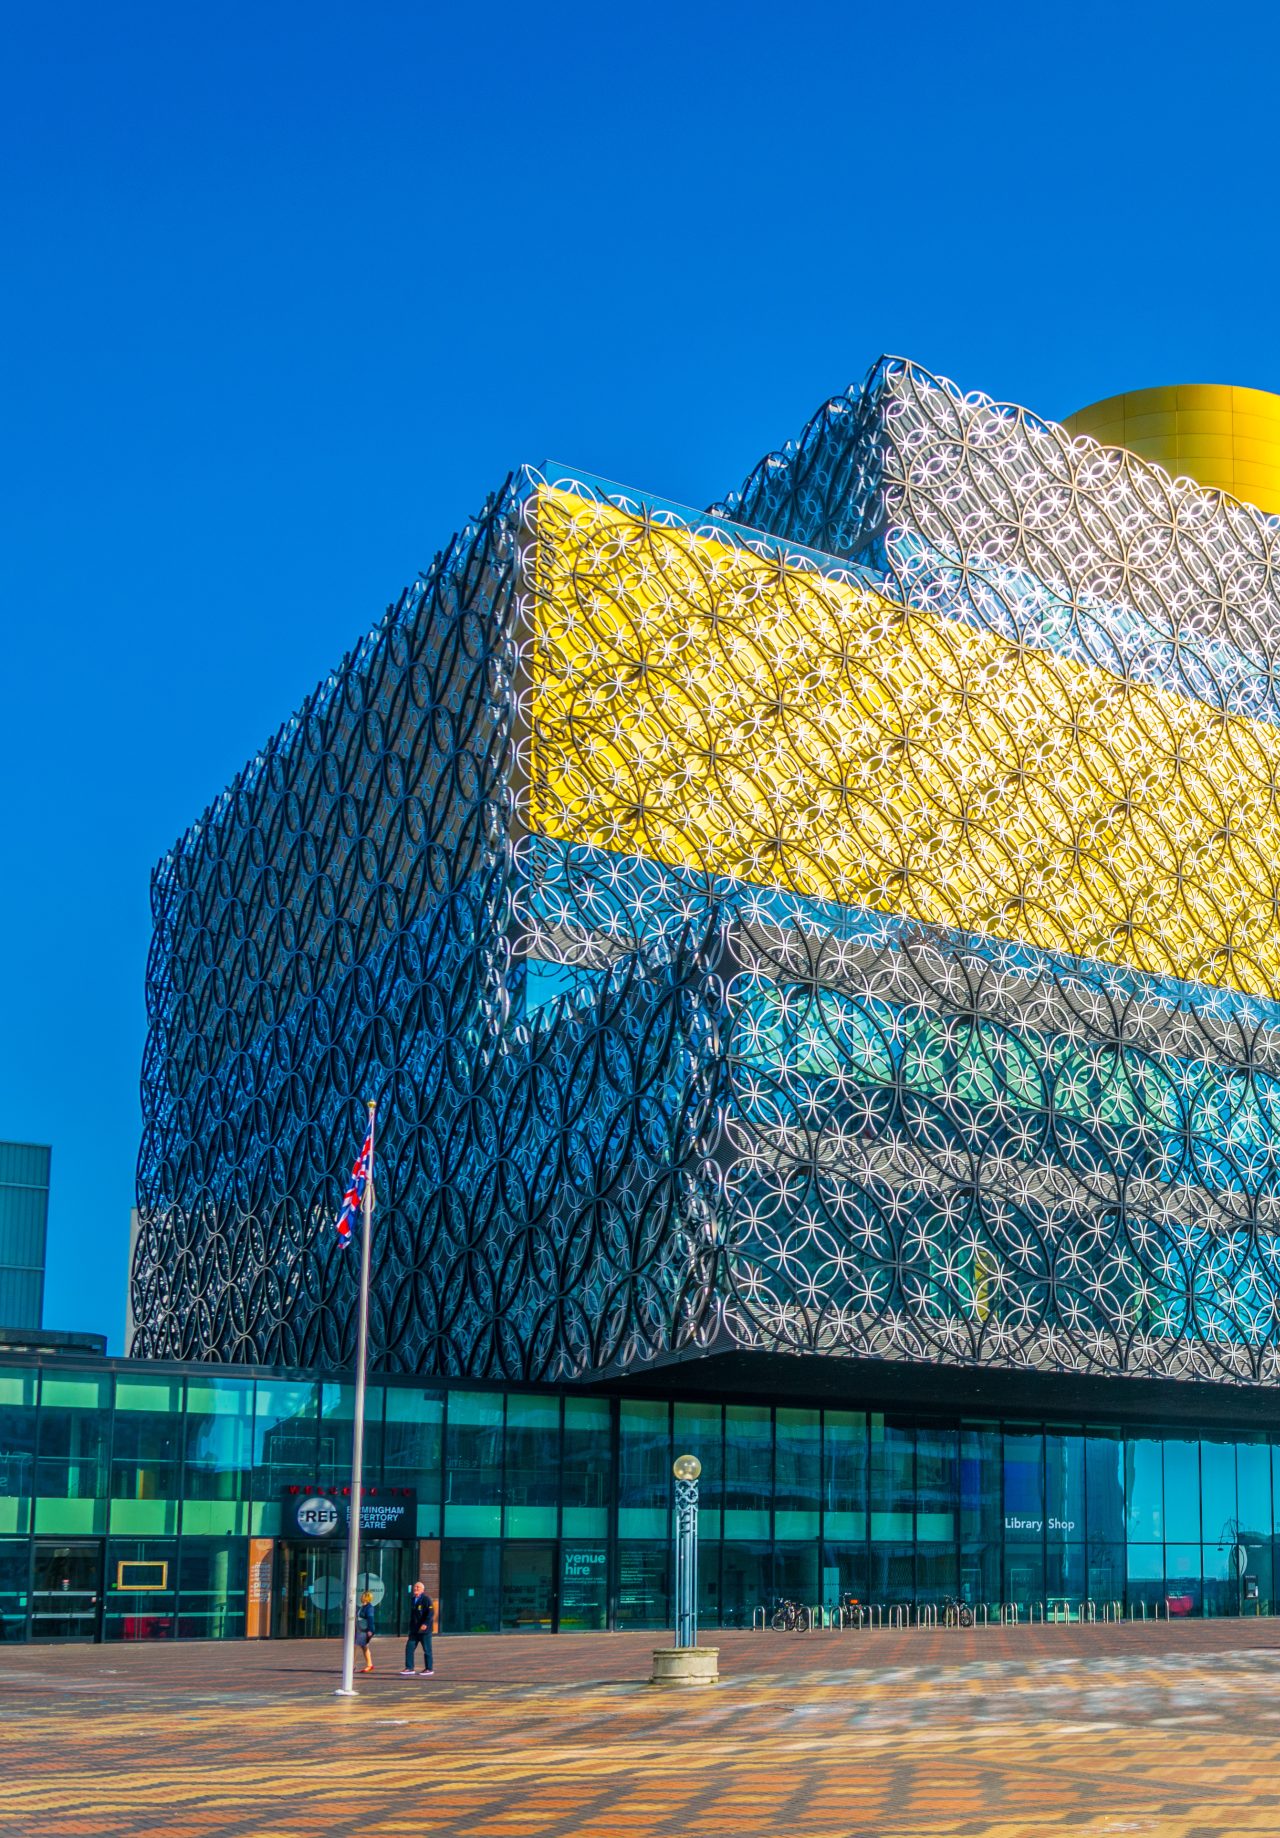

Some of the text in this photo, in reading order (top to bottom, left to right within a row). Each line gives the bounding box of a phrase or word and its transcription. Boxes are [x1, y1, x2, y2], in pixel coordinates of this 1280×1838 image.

[391, 1487, 411, 1497] TO
[346, 1506, 405, 1514] BMINGHAM
[305, 1510, 338, 1523] REP
[346, 1513, 399, 1522] RPERTORY
[346, 1521, 387, 1529] TEATRE
[1004, 1517, 1075, 1532] Library Shop
[565, 1554, 606, 1564] venue
[565, 1562, 590, 1575] hire
